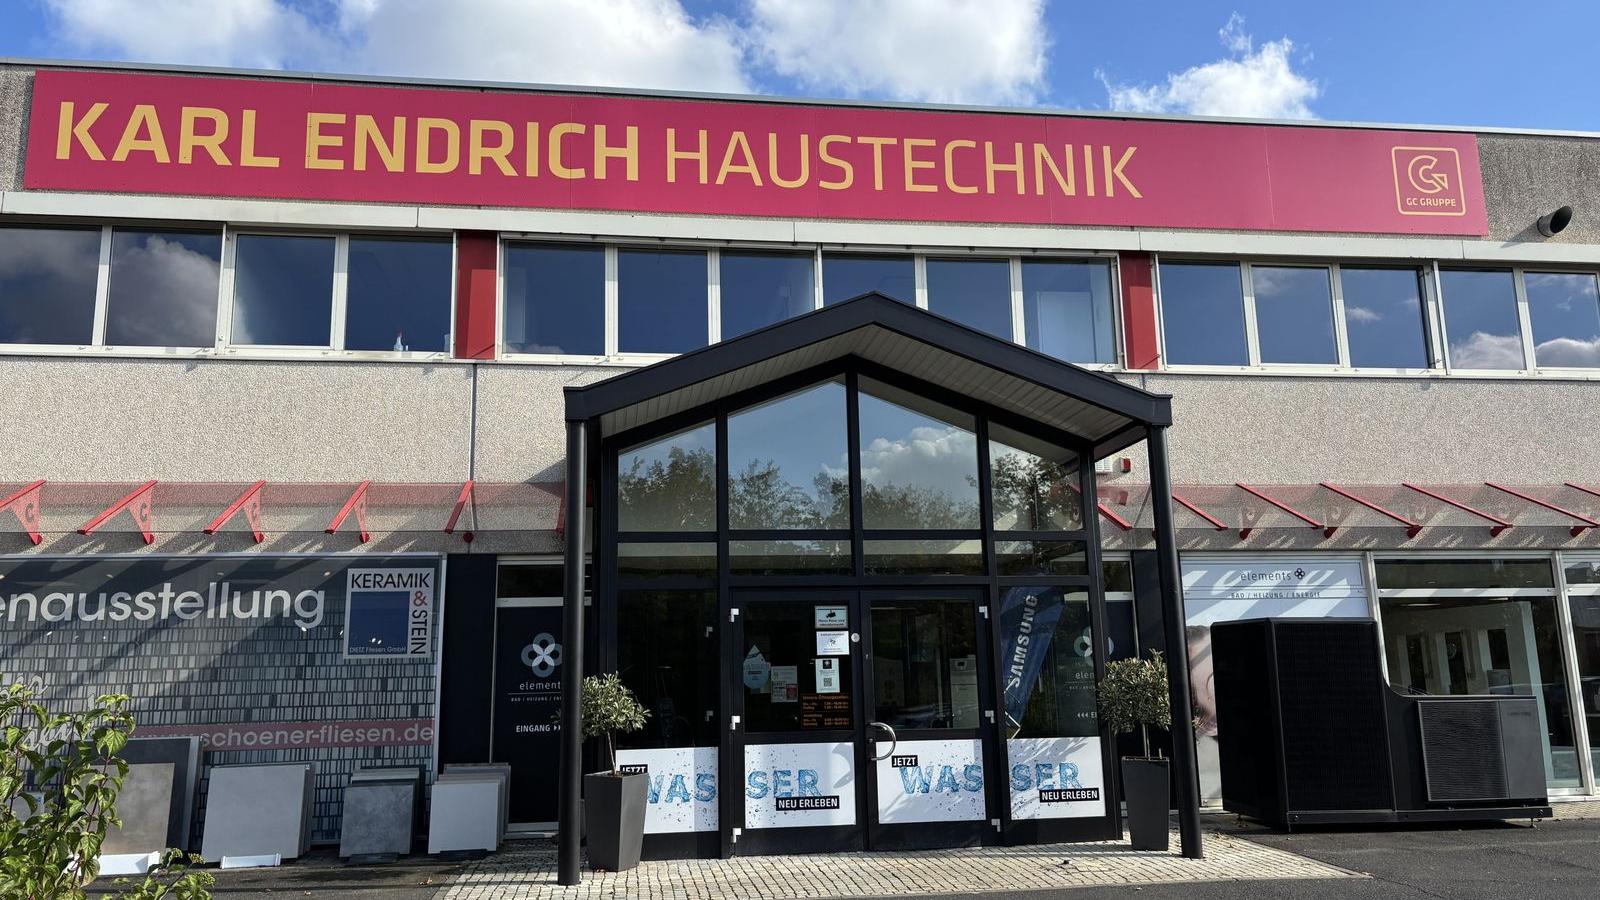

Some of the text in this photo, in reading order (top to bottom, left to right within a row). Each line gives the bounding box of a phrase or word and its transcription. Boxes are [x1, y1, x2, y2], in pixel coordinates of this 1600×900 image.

[55, 100, 1143, 198] KARL ENDRICH HAUSTECHNIK
[1406, 197, 1456, 207] GC GRUPPE
[351, 573, 430, 588] KERAMIK
[1240, 571, 1292, 581] elements
[0, 581, 325, 629] nausstellung
[410, 590, 428, 655] & STEIN
[1009, 594, 1039, 688] SAMSUNG
[519, 681, 561, 690] element
[516, 724, 551, 733] EINGANG
[893, 757, 916, 767] JETZT
[1041, 789, 1098, 801] NEU ERLEBEN
[778, 798, 839, 809] NEU ERLEBEN
